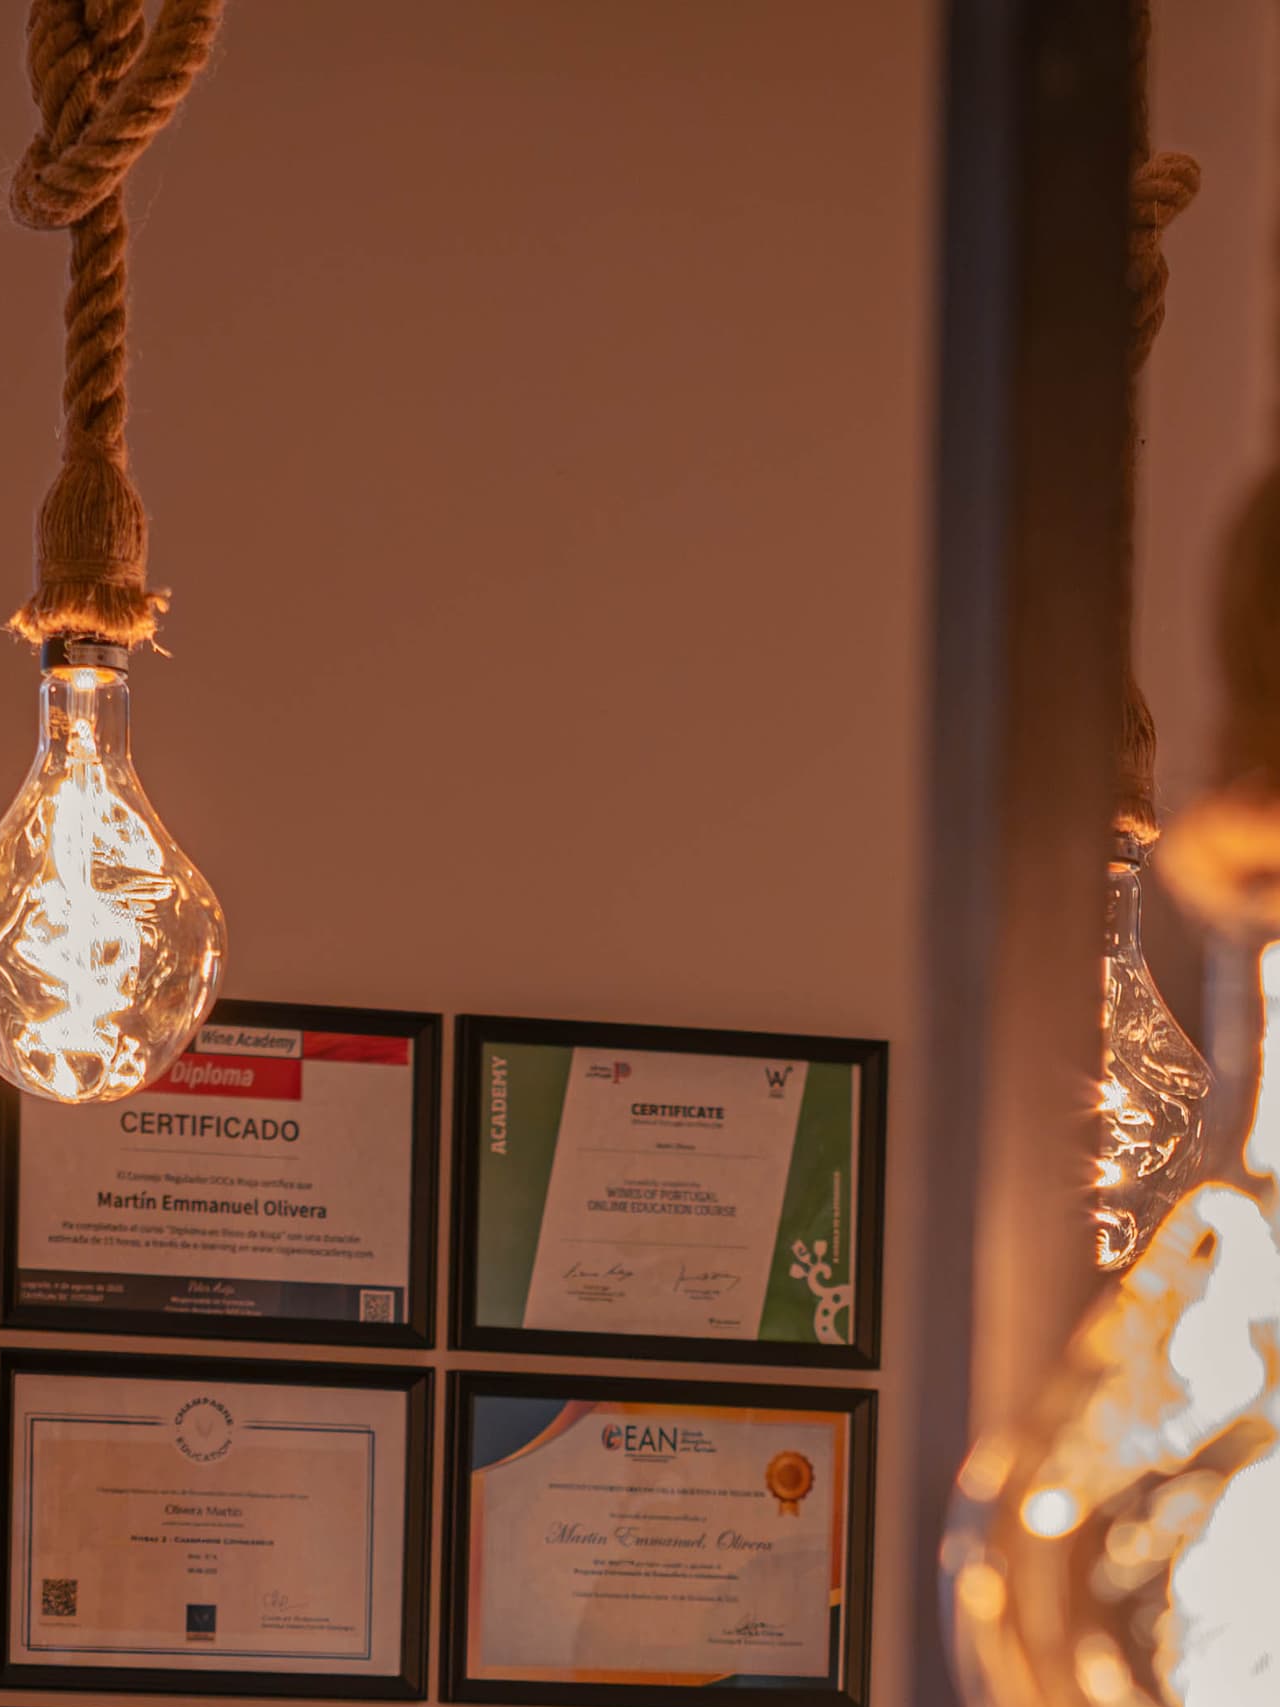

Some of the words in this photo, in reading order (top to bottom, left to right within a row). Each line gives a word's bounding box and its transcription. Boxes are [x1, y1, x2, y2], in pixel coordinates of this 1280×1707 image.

[200, 1030, 235, 1049] Wine
[237, 1032, 297, 1054] Academy
[170, 1059, 255, 1088] Diploma
[490, 1056, 508, 1155] ACADEMY
[630, 1102, 725, 1120] CERTIFICATE
[120, 1110, 301, 1142] CERTIFICADO
[97, 1190, 157, 1210] Martín
[161, 1193, 259, 1216] Emmanuel
[263, 1199, 328, 1219] Olivera
[587, 1200, 629, 1213] ONLINE
[630, 1202, 693, 1215] EDUCATION
[694, 1204, 737, 1217] COURSE
[605, 1186, 642, 1199] WINES
[643, 1188, 658, 1200] OF
[659, 1189, 719, 1203] PORTUGAL
[174, 1396, 235, 1426] CHAMPAGNE
[174, 1437, 234, 1463] EDUCATION
[625, 1424, 678, 1452] EAN
